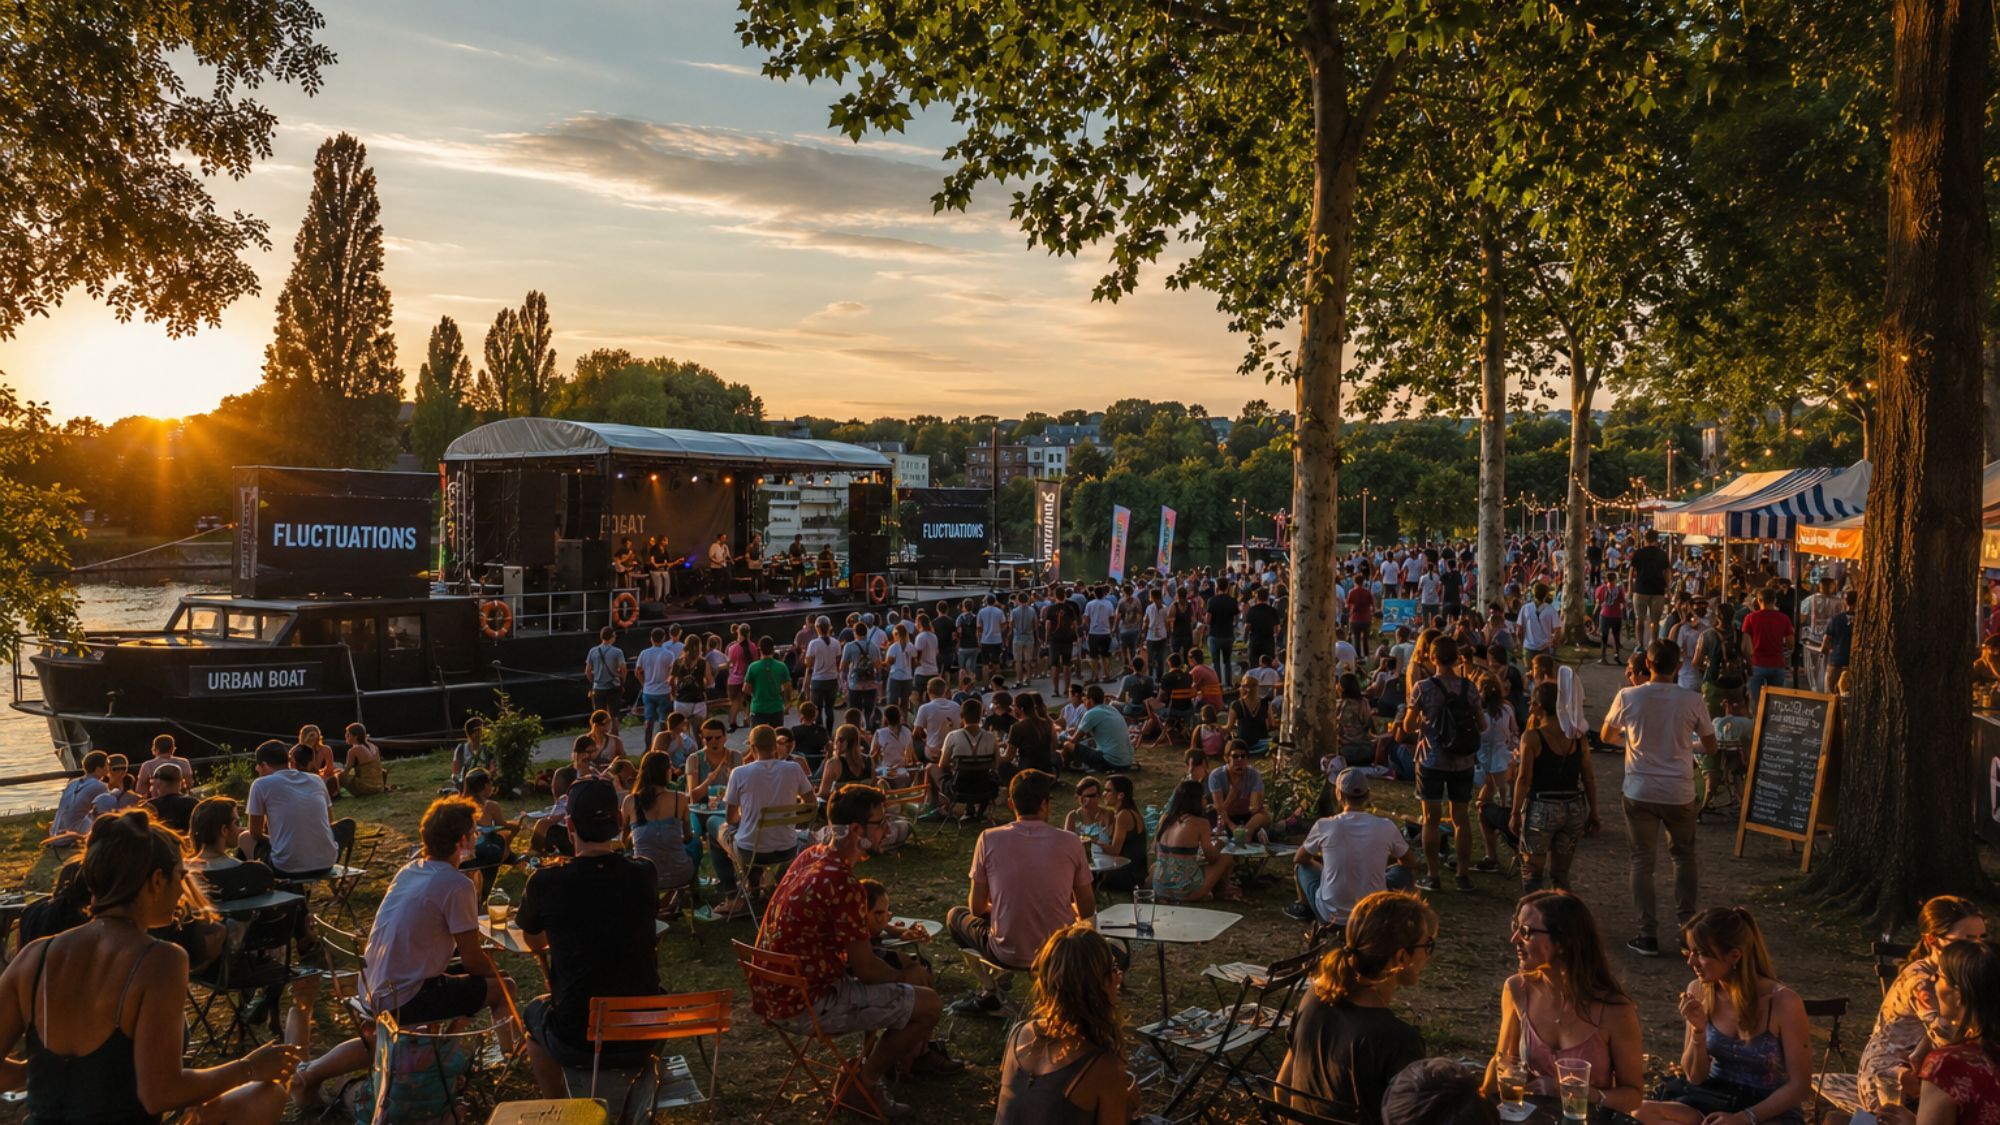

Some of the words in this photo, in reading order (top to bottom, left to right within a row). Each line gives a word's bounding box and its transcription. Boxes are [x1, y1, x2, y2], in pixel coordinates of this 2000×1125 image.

[273, 523, 417, 550] FLUCTUATIONS
[922, 522, 984, 539] FLUCTUATIONS
[207, 671, 264, 690] URBAN
[268, 669, 307, 688] BOAT
